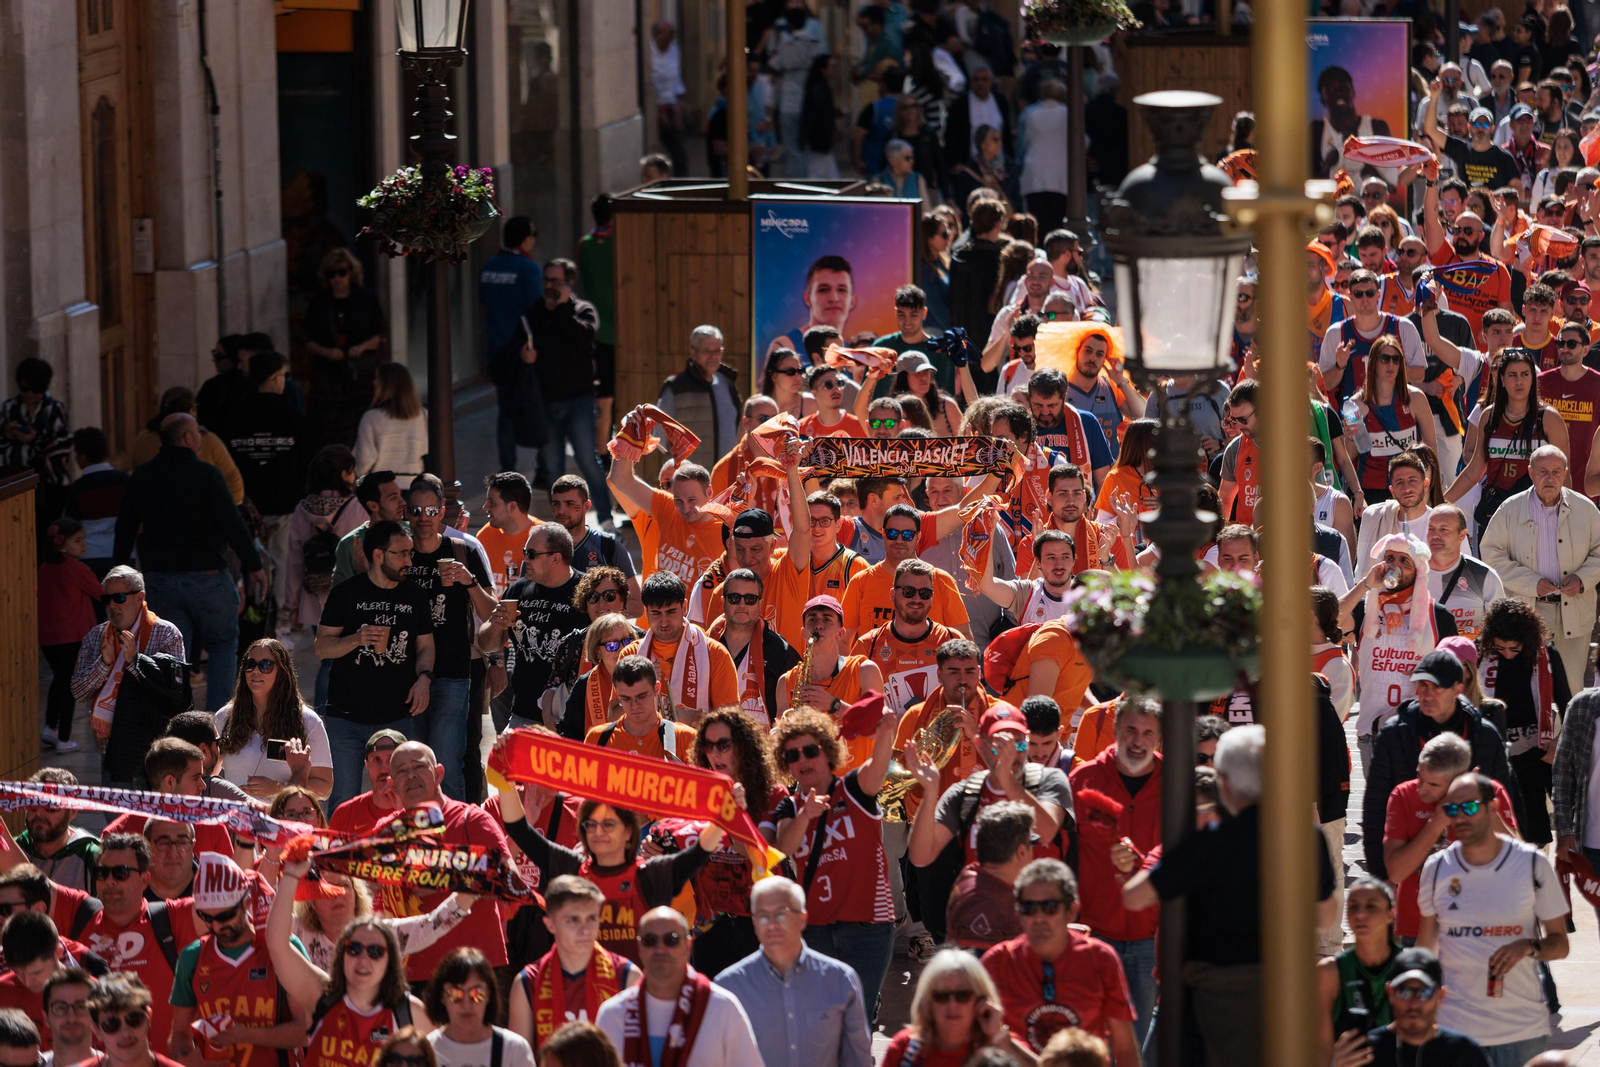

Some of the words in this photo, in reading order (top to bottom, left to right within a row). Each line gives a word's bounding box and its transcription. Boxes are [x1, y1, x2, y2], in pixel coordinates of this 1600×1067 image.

[1553, 399, 1594, 414] BARCELONA
[842, 443, 910, 467] VALENCIA
[913, 442, 970, 466] BASKET
[895, 465, 916, 473] CLUB
[1503, 462, 1518, 478] 15
[1244, 485, 1262, 496] Cul
[666, 546, 685, 561] PER
[406, 565, 429, 576] ERTE
[415, 579, 434, 590] IKI
[356, 601, 391, 611] MUERTE
[519, 599, 550, 609] MUERTE
[374, 613, 397, 626] KIKI
[528, 611, 551, 623] KIKI
[1372, 646, 1415, 661] Cultura
[1371, 658, 1418, 673] Esfuerz
[590, 682, 600, 698] DEL
[592, 698, 604, 720] COPA
[530, 745, 599, 789] UCAM
[606, 763, 698, 810] MURCIA
[707, 785, 737, 822] CB
[794, 814, 856, 859] BXI
[404, 848, 489, 872] MURCIA
[348, 860, 406, 882] FIEBRE
[407, 868, 451, 888] ROJA
[817, 874, 833, 903] 3
[600, 904, 635, 927] AM
[598, 927, 637, 941] RSIDAD
[1447, 925, 1524, 938] AUTOHERO
